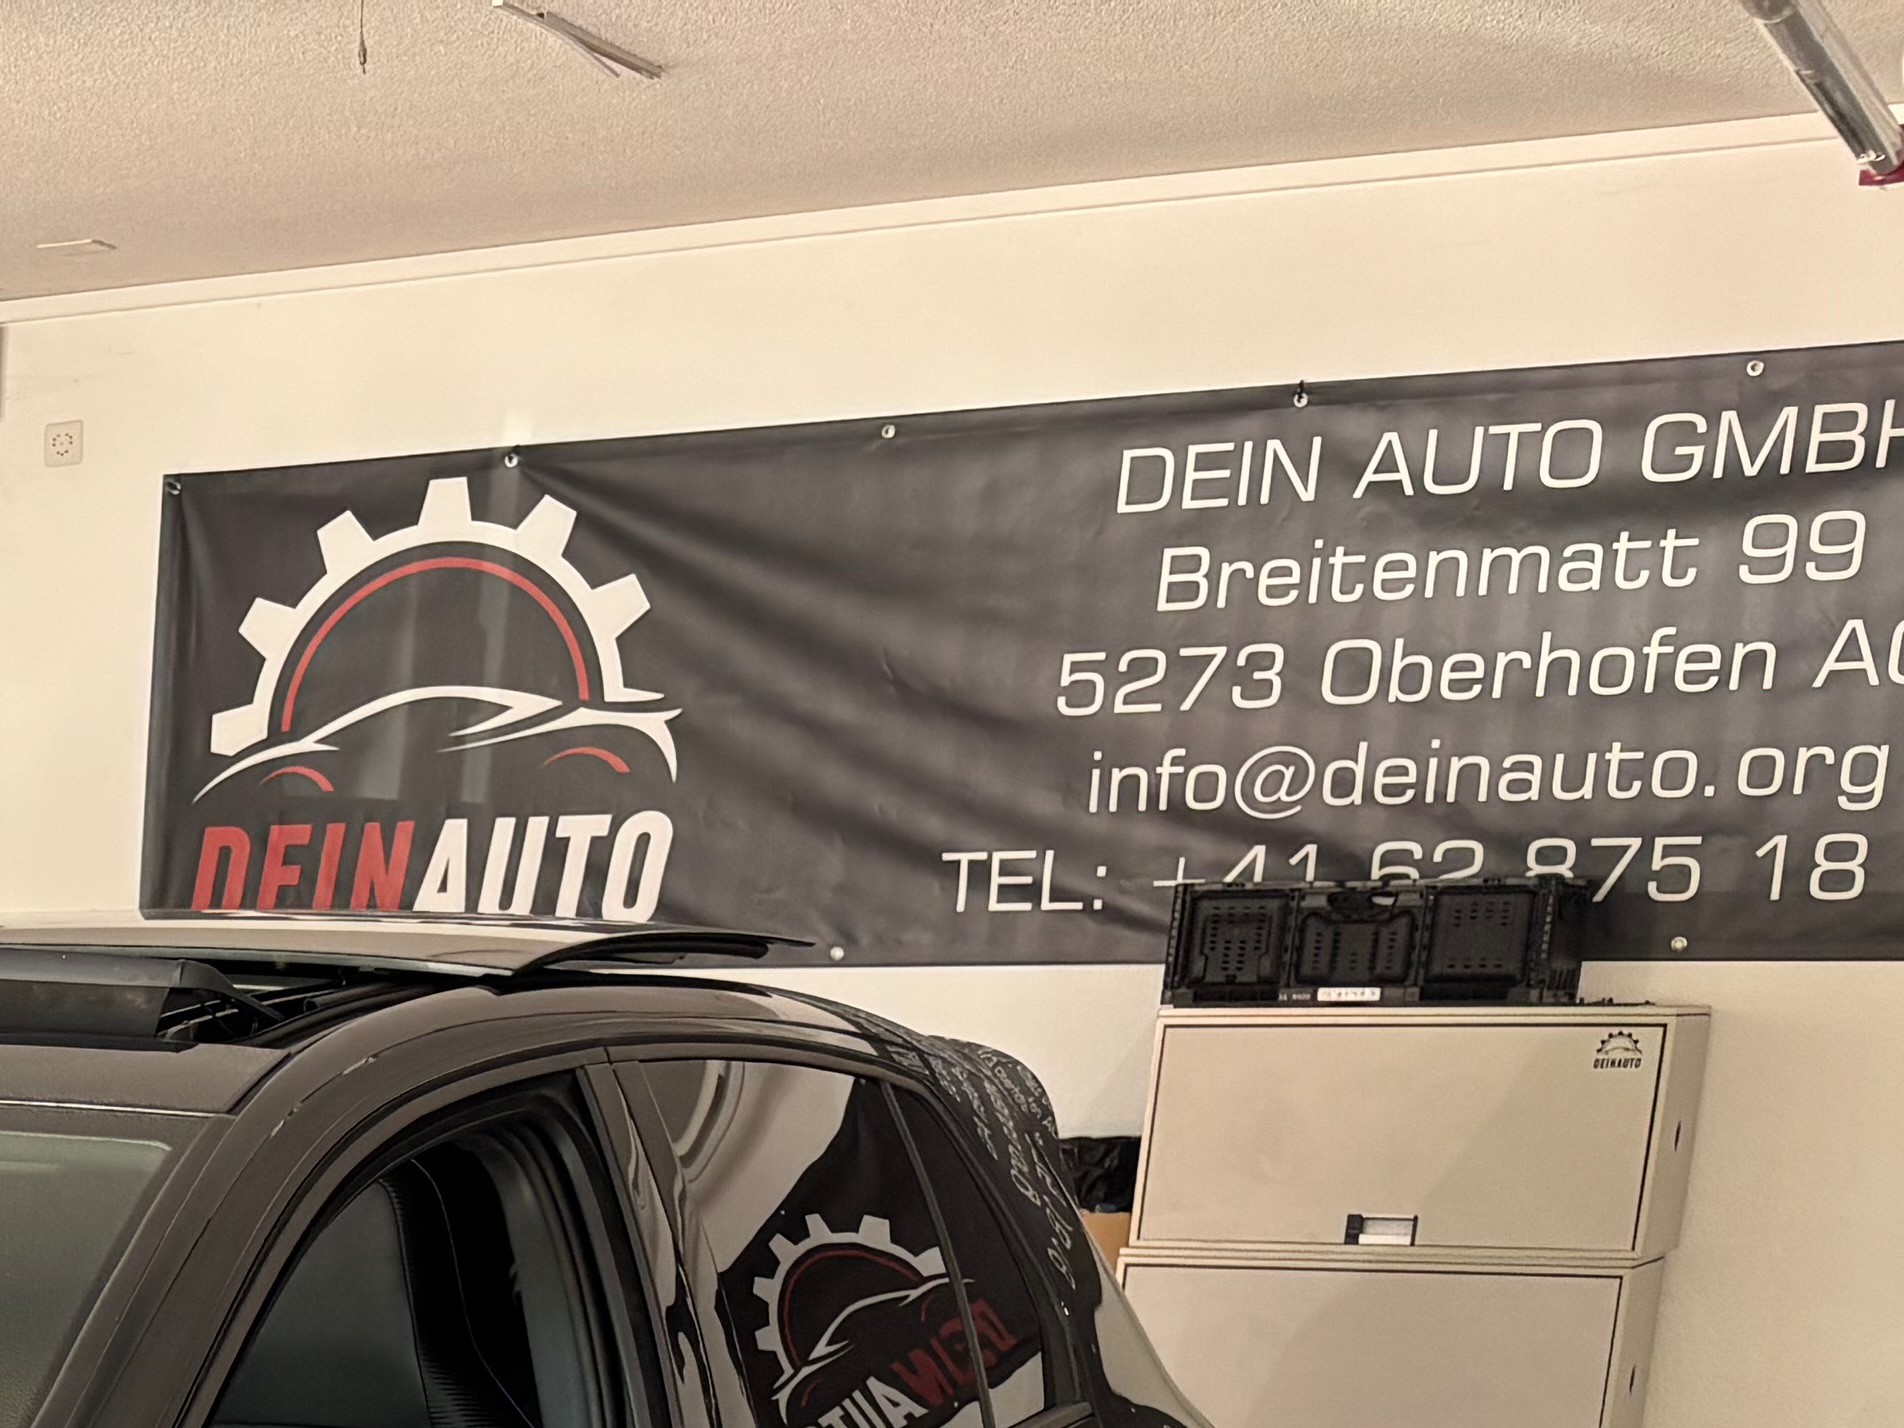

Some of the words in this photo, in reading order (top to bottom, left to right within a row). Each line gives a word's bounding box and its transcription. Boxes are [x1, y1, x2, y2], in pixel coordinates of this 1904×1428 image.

[1116, 436, 1322, 514] DEIN
[1352, 419, 1603, 499] AUTO
[1156, 528, 1700, 612] Breitenmatt
[1738, 510, 1866, 584] 99
[1057, 643, 1284, 716] 5273
[1321, 626, 1776, 705] Oberhofen
[1812, 619, 1904, 688] A
[1089, 738, 1890, 819] info@deinauto.org
[192, 810, 673, 923] DEINAUTO
[942, 849, 1107, 913] TEL:
[1755, 833, 1868, 900] 18
